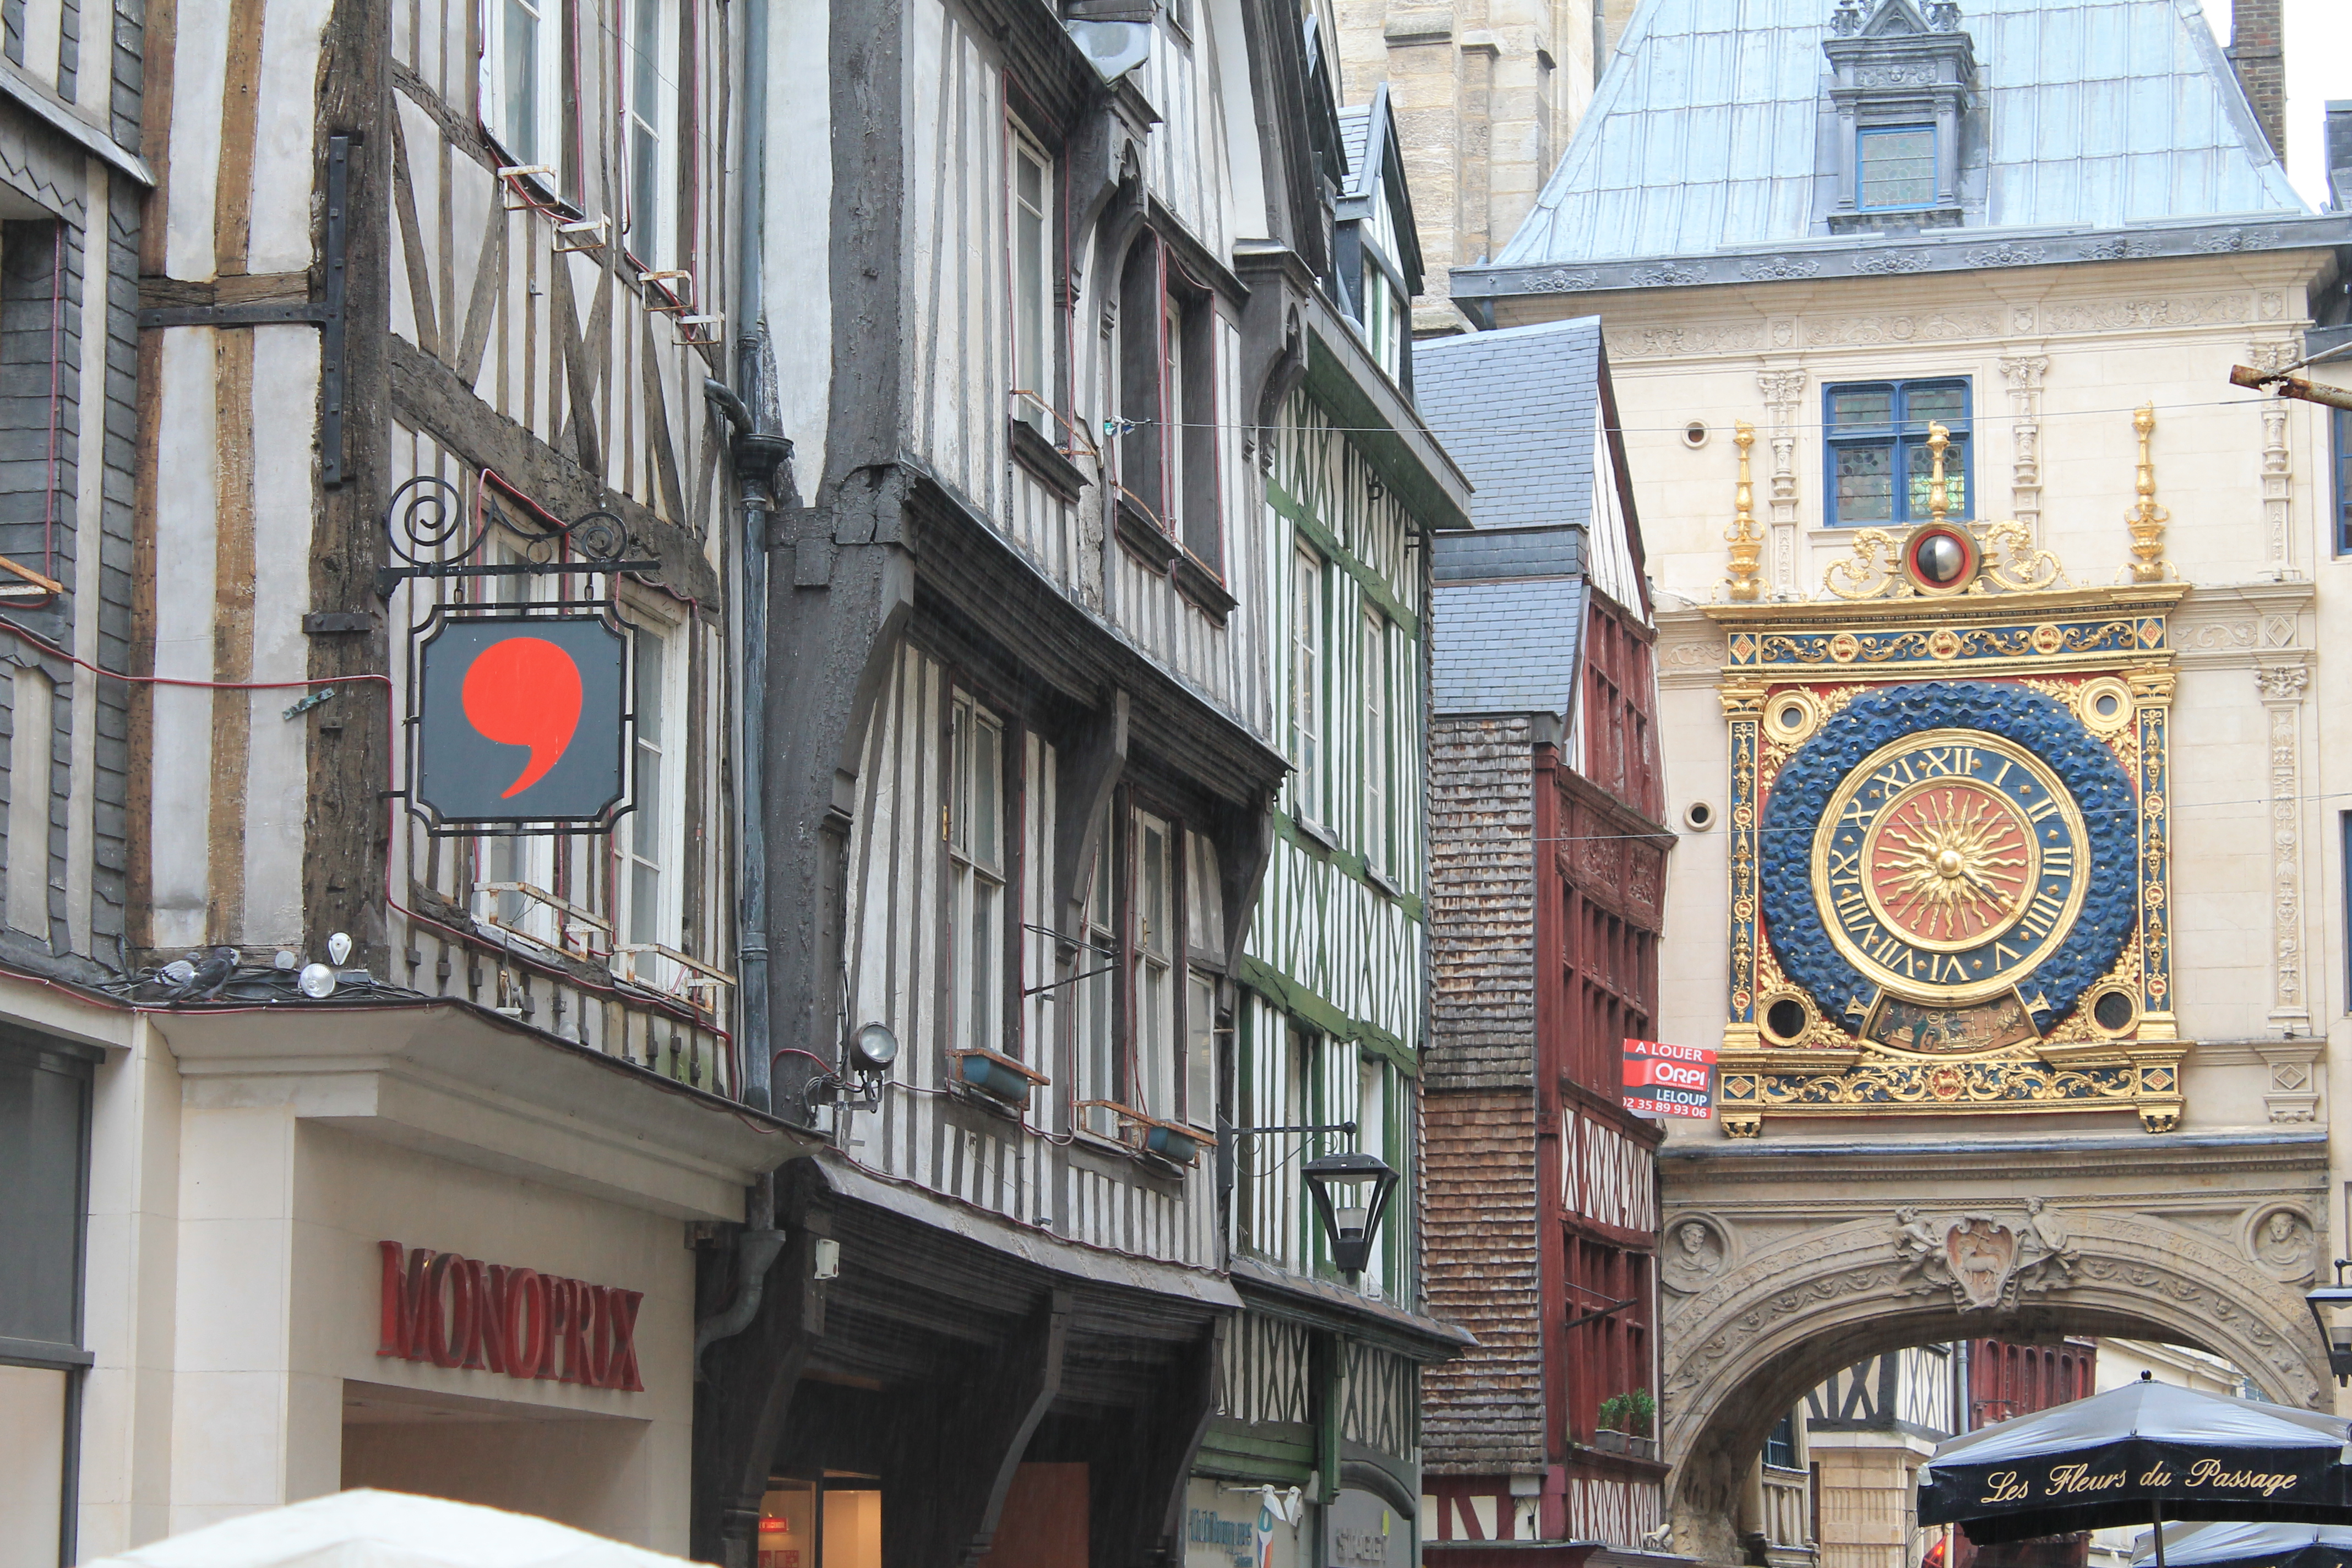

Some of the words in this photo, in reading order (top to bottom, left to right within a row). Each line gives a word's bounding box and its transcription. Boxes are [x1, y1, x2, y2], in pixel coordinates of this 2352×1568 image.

[1923, 748, 1974, 778] XII
[1993, 760, 2013, 786] I
[1872, 758, 1918, 800] XI
[1842, 798, 1877, 832] X
[2026, 796, 2058, 824] II
[1831, 849, 1859, 887] IX
[2043, 846, 2072, 878] III
[1836, 891, 1878, 950] VIII
[2021, 891, 2064, 939] IIII
[1871, 935, 1915, 978] VII
[1928, 954, 1970, 983] VI
[1995, 941, 2023, 971] V
[1635, 1042, 1646, 1054] A
[1652, 1043, 1703, 1062] LOUER
[1655, 1063, 1705, 1086] ORPI
[1637, 1099, 1653, 1110] 35
[1655, 1102, 1671, 1113] 89
[1674, 1104, 1689, 1115] 93
[1692, 1107, 1707, 1118] 06
[1656, 1088, 1707, 1107] LELOUP
[377, 1240, 644, 1392] MONOPRIX
[1981, 1471, 2029, 1503] Les
[2045, 1463, 2126, 1495] Fleurs
[2139, 1461, 2172, 1487] du
[2185, 1458, 2297, 1496] Passage
